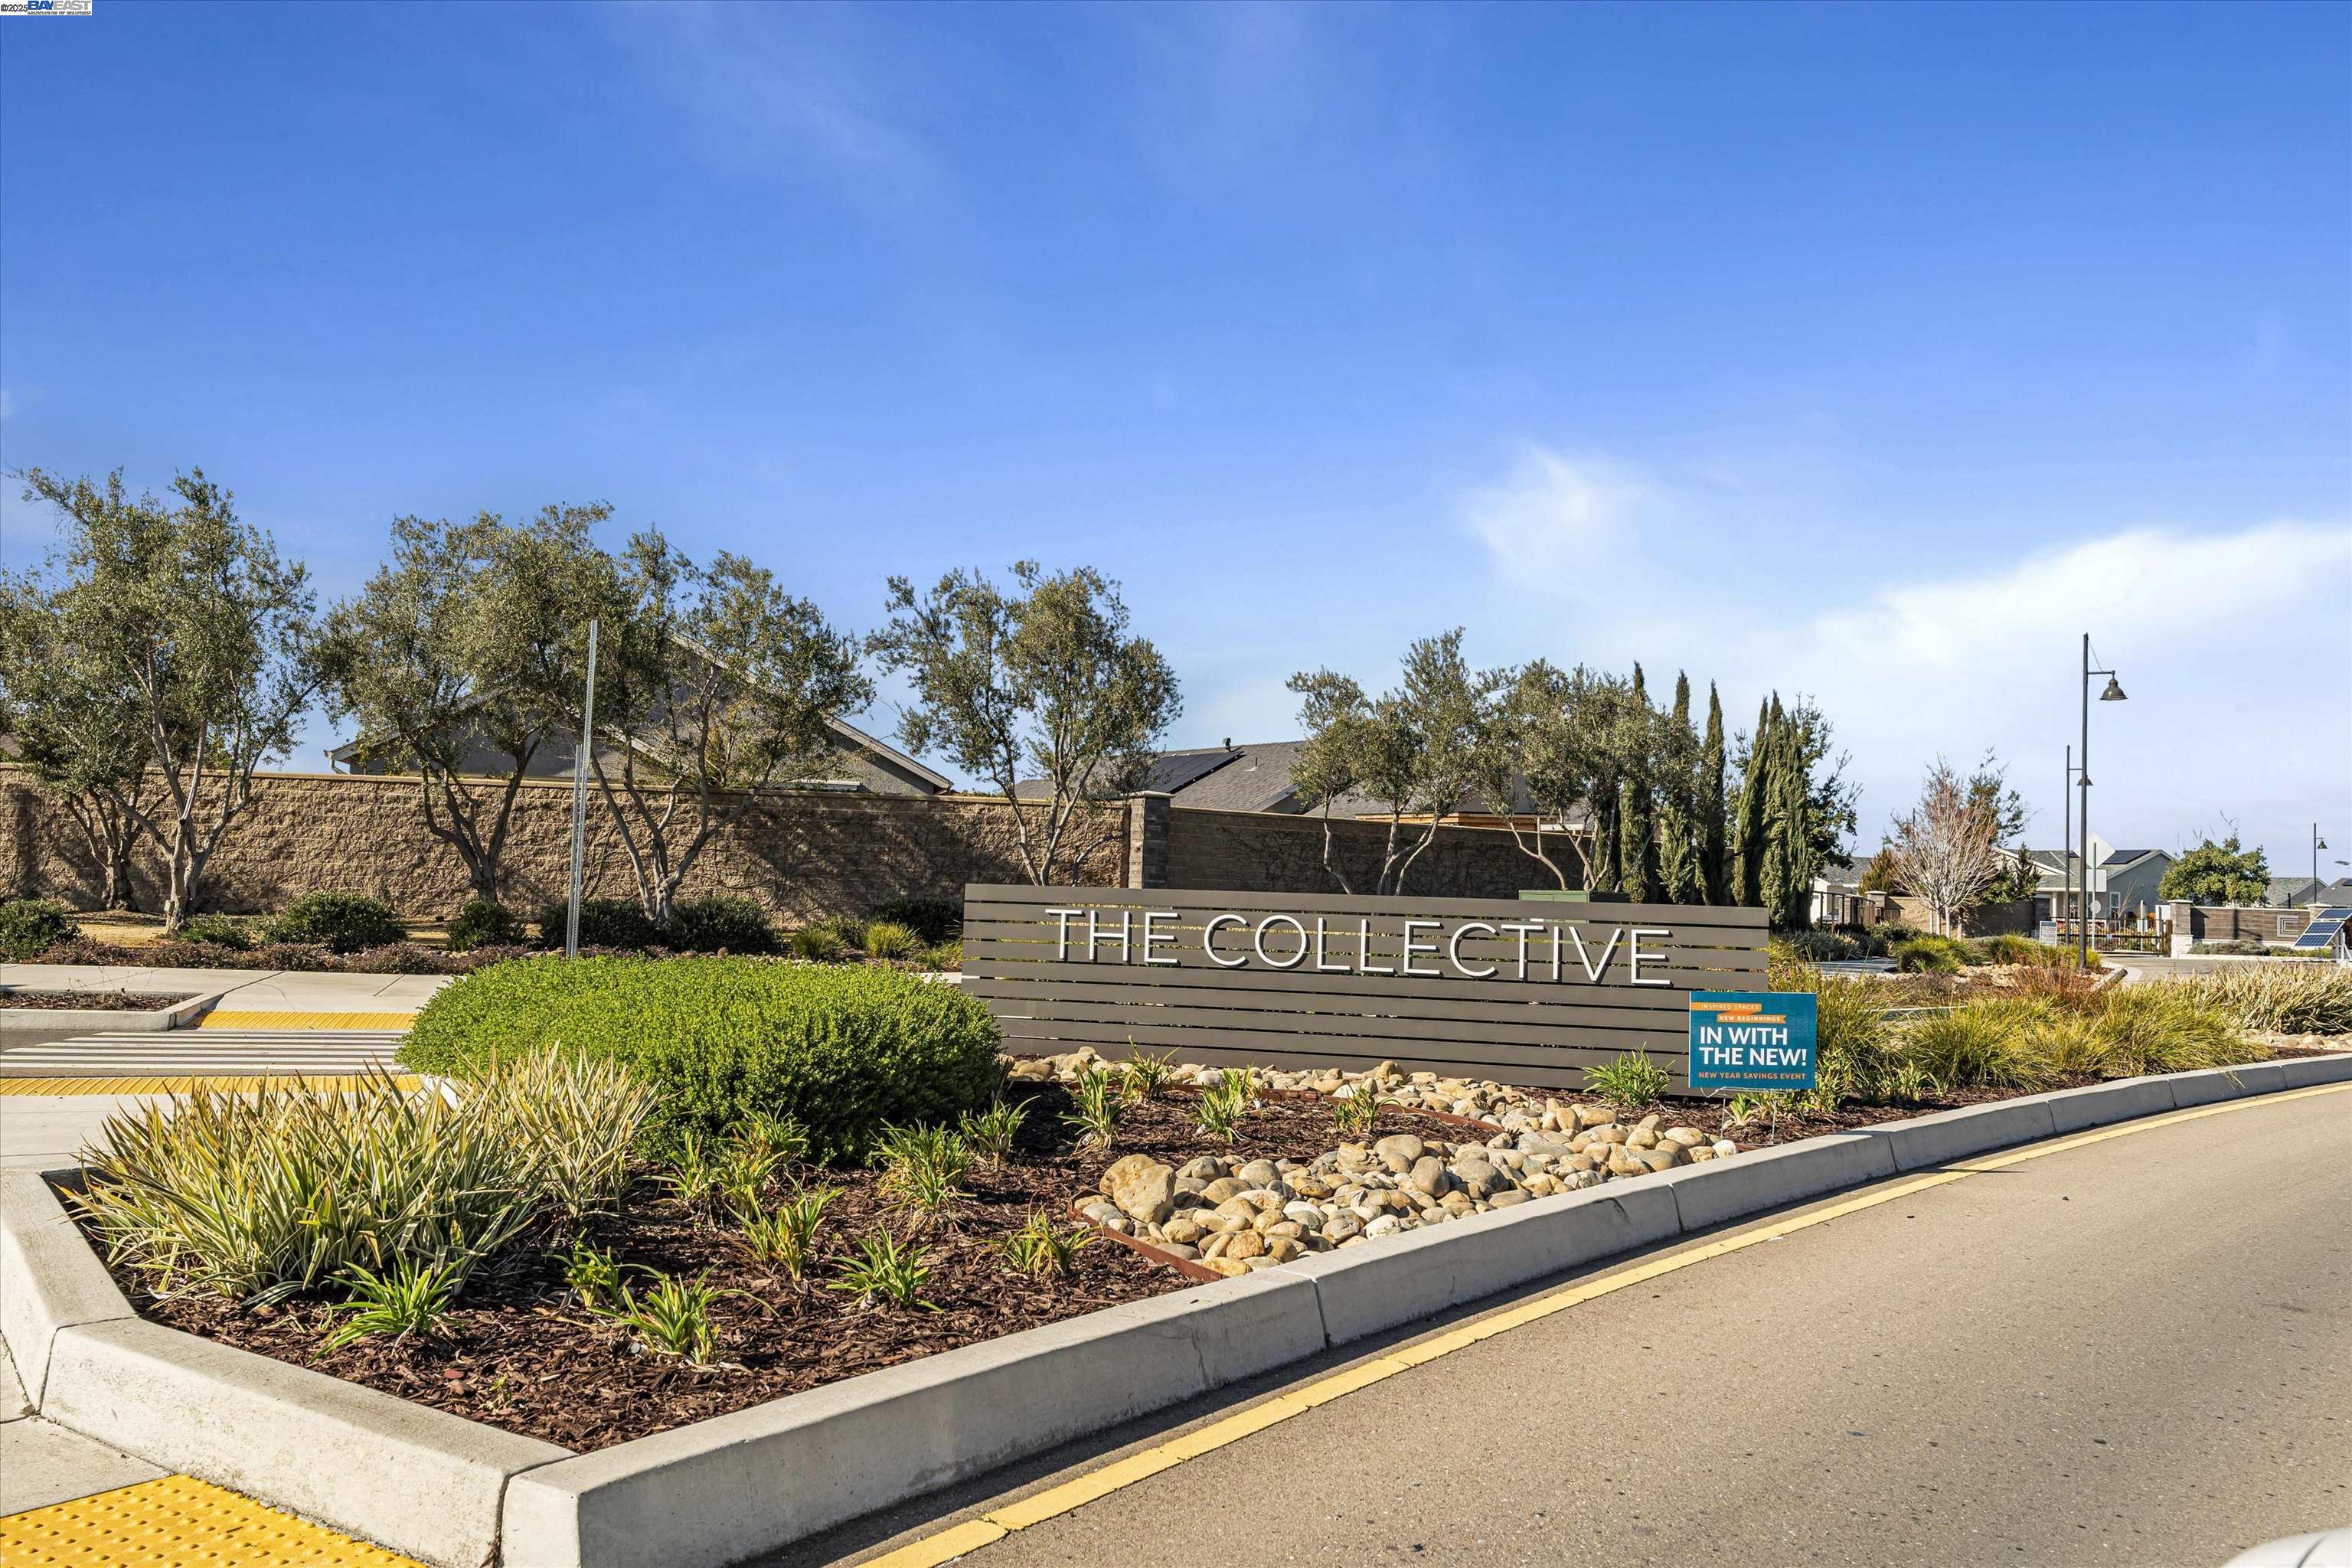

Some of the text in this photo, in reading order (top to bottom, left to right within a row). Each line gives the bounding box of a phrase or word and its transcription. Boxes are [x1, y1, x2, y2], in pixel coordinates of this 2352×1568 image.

[1045, 909, 1671, 985] THE COLLECTIVE
[1700, 1026, 1788, 1045] IN WITH
[1699, 1047, 1807, 1066] THE NEW!
